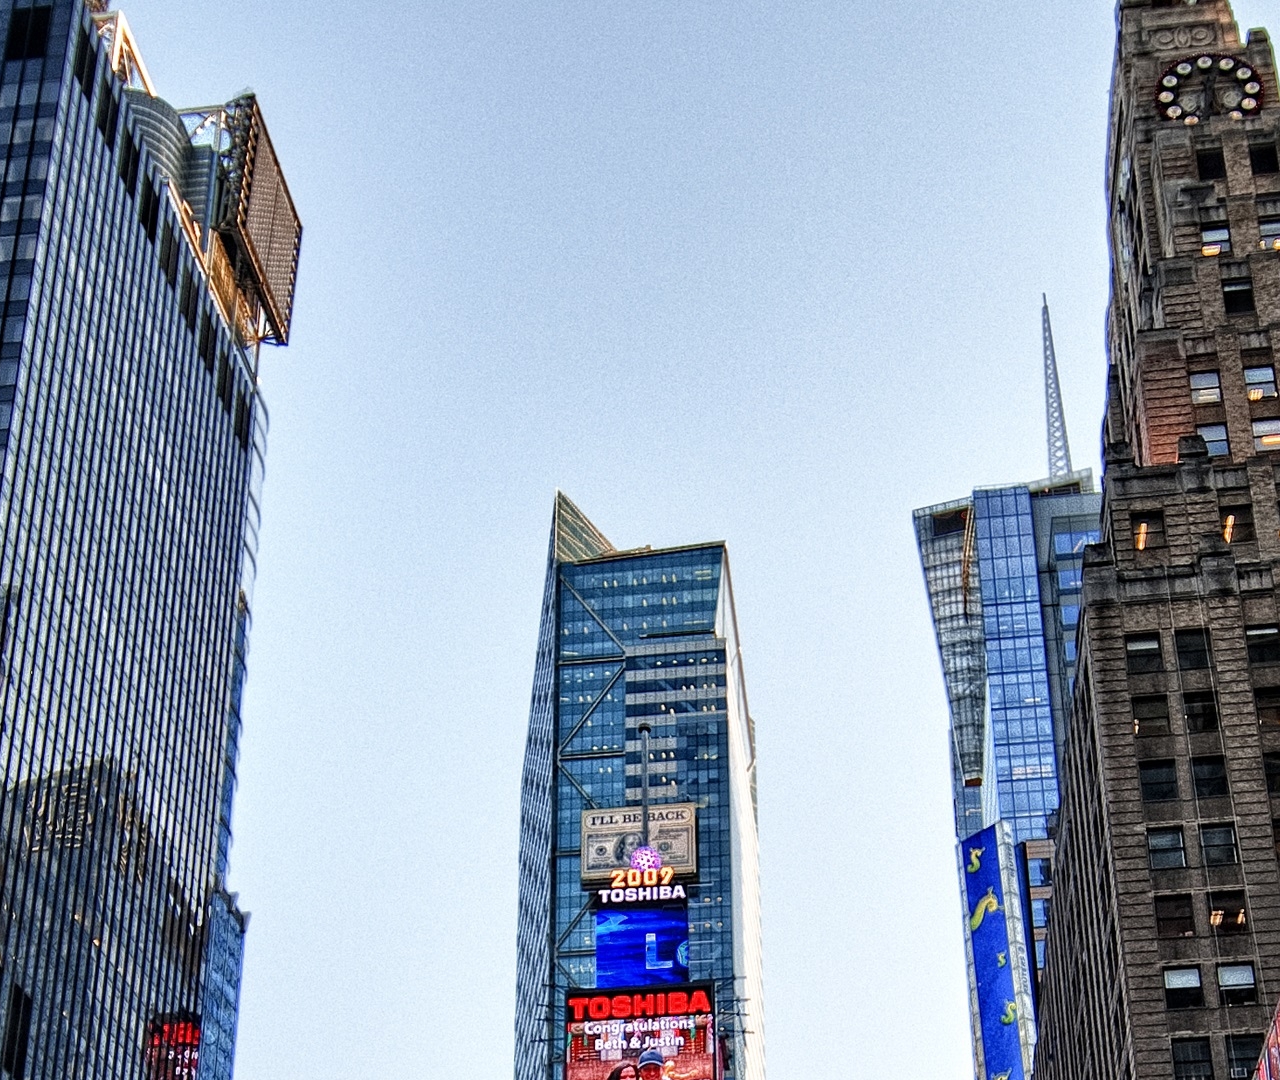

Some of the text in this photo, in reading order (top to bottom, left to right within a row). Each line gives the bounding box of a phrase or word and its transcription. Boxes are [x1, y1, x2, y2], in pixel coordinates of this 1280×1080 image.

[590, 809, 687, 827] I'LL BE BACK
[598, 884, 686, 904] TOSHIBA
[568, 990, 711, 1021] TOSHIBA
[584, 1017, 695, 1036] Congratulations
[594, 1035, 685, 1050] Beth & Justin
